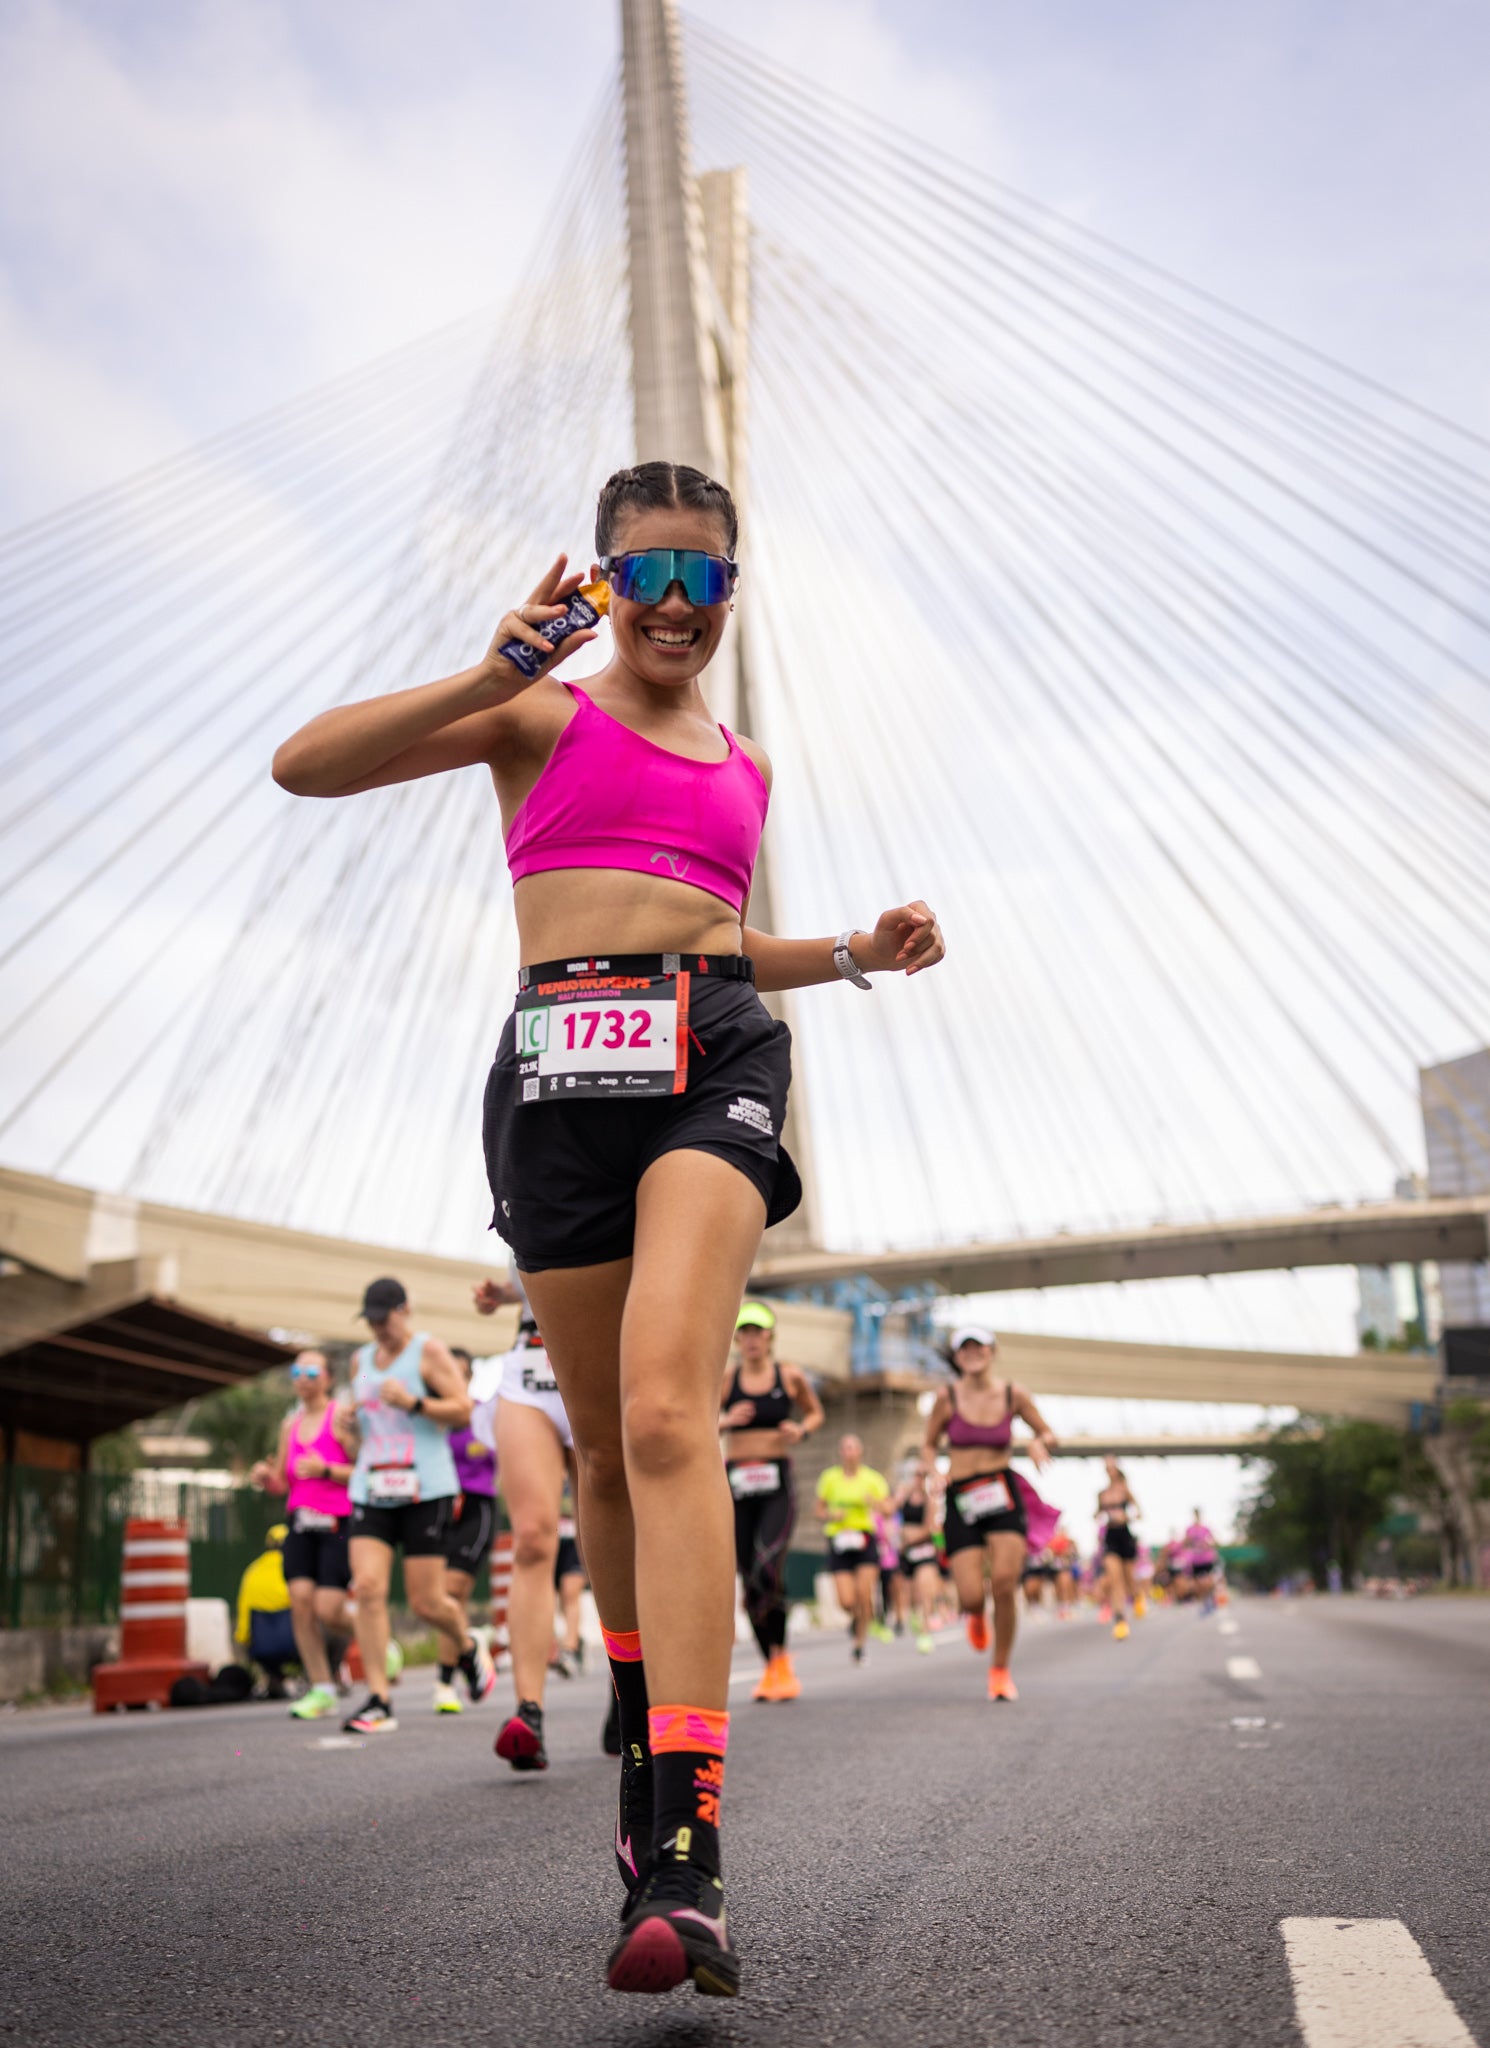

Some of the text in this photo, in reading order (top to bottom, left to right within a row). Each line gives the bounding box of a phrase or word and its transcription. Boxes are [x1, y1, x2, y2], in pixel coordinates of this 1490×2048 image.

[537, 979, 579, 996] VENUS
[557, 989, 621, 1001] HALF MARATHON
[529, 1014, 541, 1047] C
[563, 1009, 652, 1050] 1732
[597, 1077, 619, 1086] Jeep
